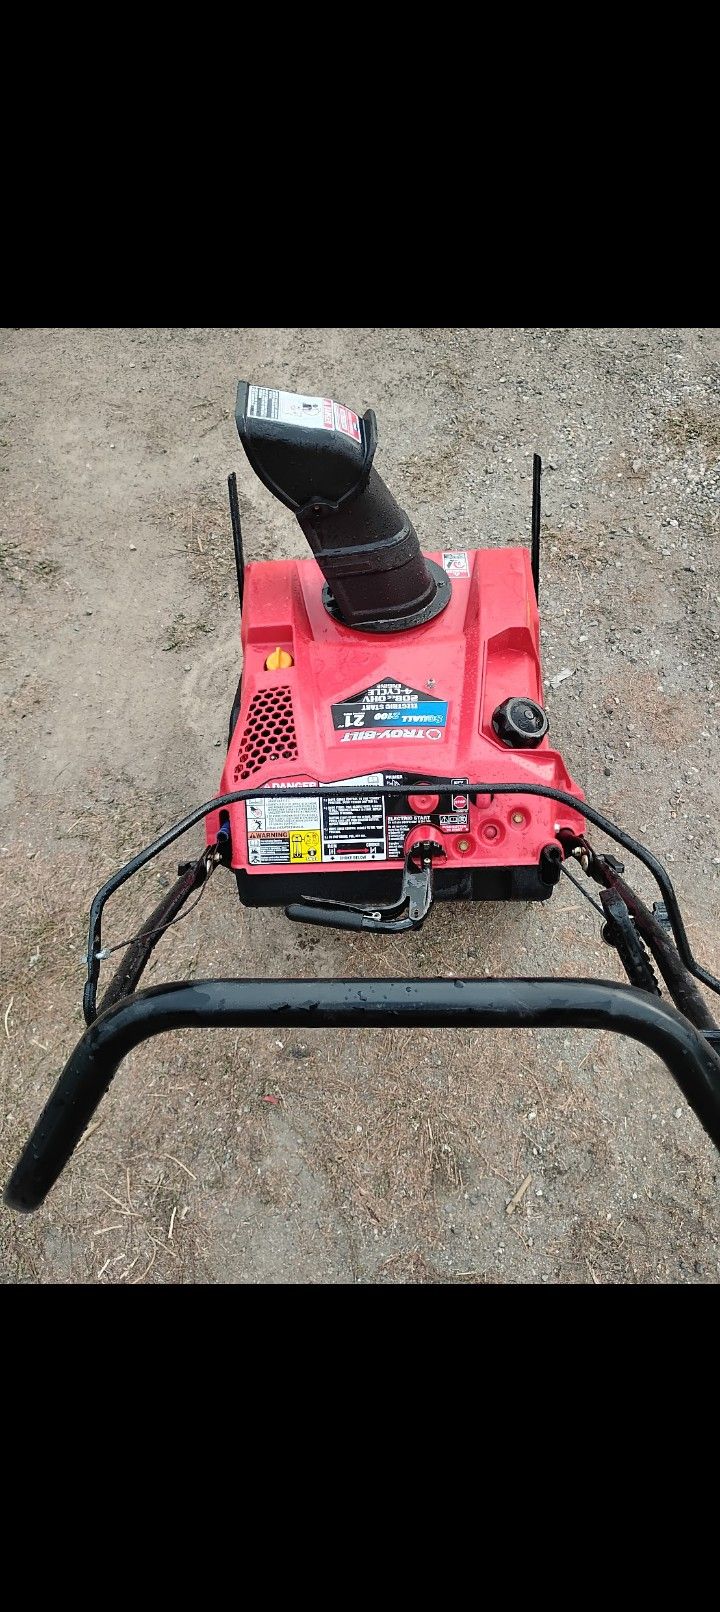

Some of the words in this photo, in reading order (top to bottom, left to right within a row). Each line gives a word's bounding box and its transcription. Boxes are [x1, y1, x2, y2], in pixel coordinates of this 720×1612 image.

[361, 703, 384, 711] START
[401, 714, 443, 723] SQUALL
[341, 729, 425, 742] TROY-BILT
